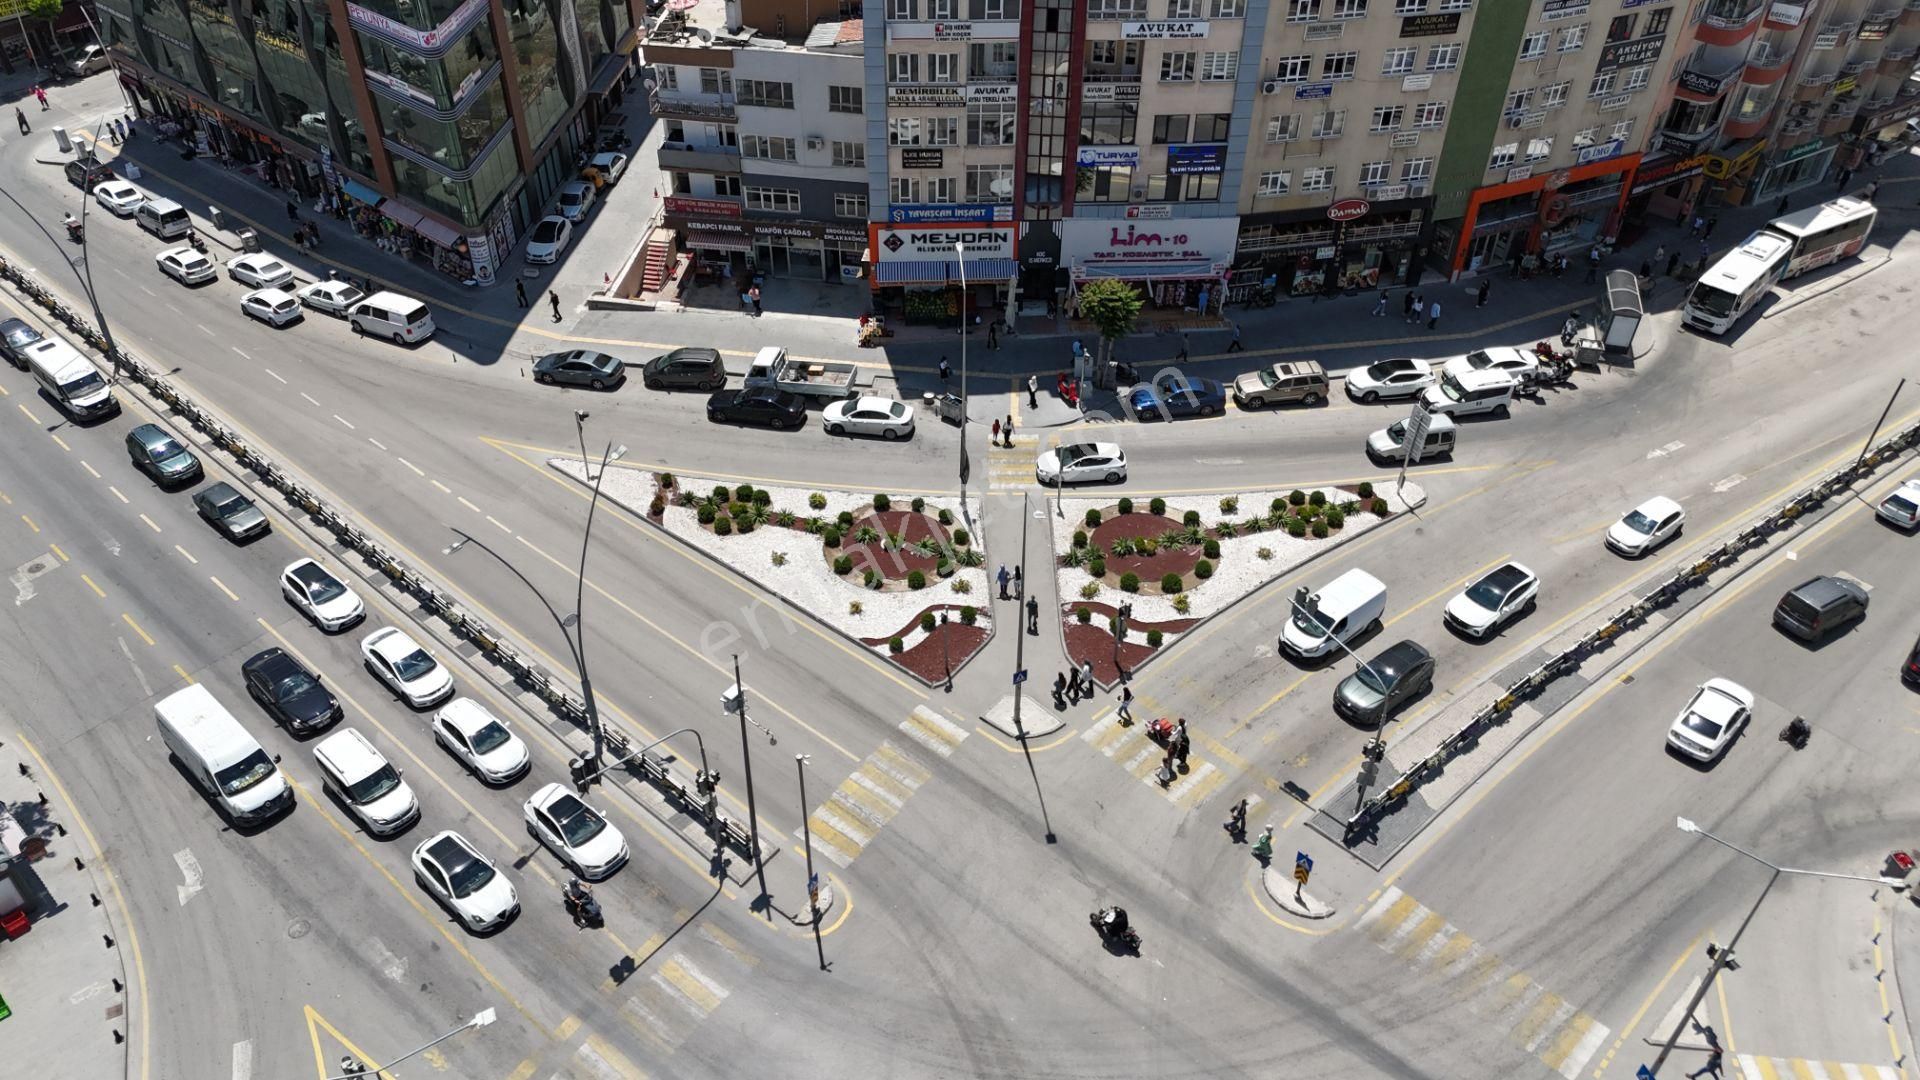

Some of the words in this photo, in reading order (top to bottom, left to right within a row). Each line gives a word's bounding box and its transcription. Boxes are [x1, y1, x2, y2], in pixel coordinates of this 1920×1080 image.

[349, 5, 390, 31] PETUNYA
[1415, 16, 1449, 25] AVUKAT
[1138, 23, 1193, 32] AVUKAT
[1617, 40, 1662, 56] AKSİYON
[1619, 51, 1653, 64] EMLAK
[954, 208, 986, 217] İNŞAAT
[1331, 204, 1367, 217] Damak
[755, 226, 782, 235] KUAFÖR
[783, 227, 812, 237] ÇAĞDAŞ
[911, 232, 1008, 244] MEYDAN
[1173, 234, 1188, 245] 10
